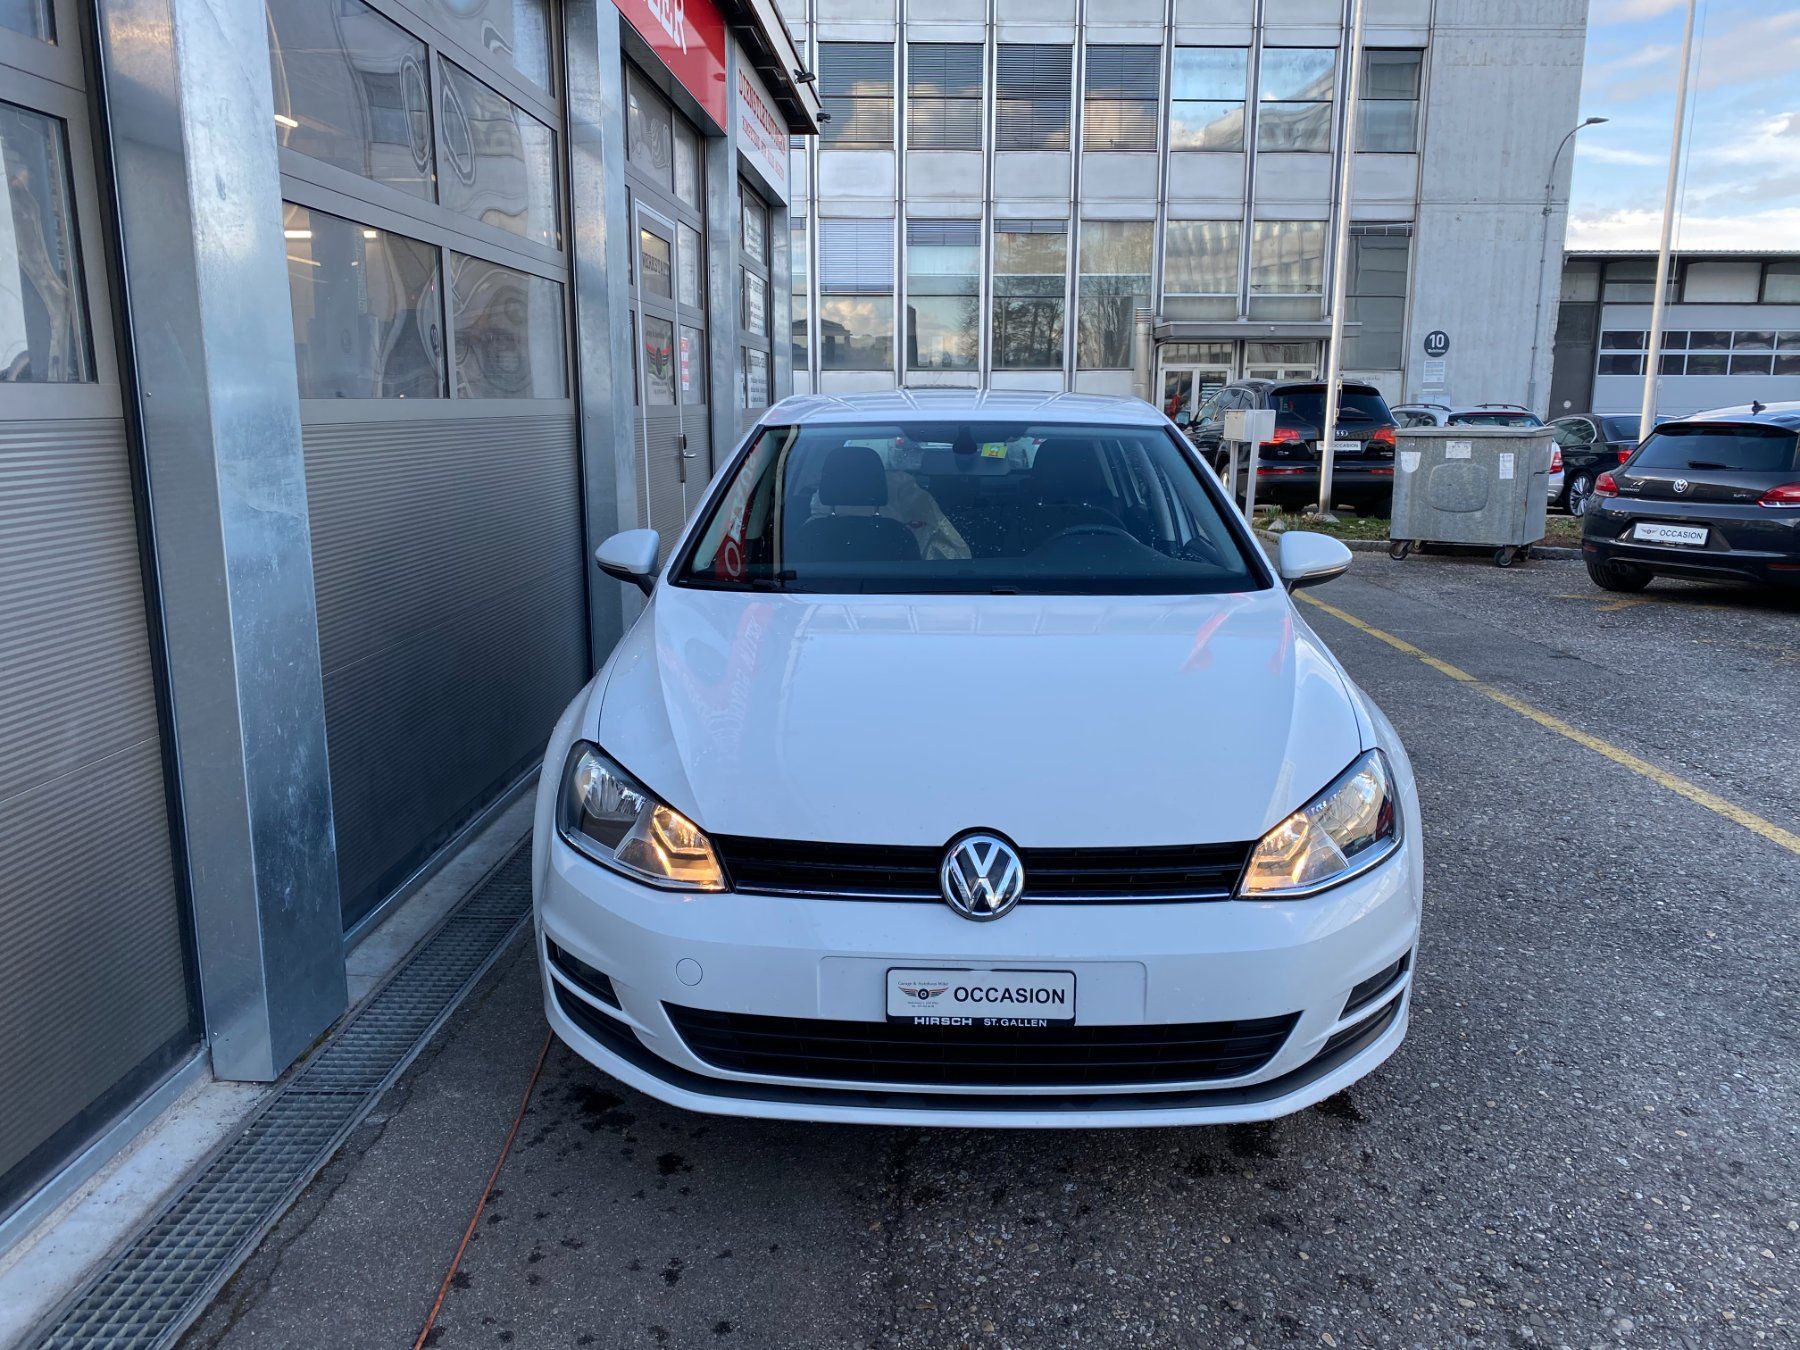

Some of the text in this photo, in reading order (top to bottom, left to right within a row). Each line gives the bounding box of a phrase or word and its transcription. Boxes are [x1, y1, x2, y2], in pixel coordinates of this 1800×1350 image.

[1430, 334, 1445, 348] 10
[1659, 529, 1703, 539] OCCASION
[953, 986, 1065, 1004] OCCASION
[914, 1017, 972, 1026] HIRSCH
